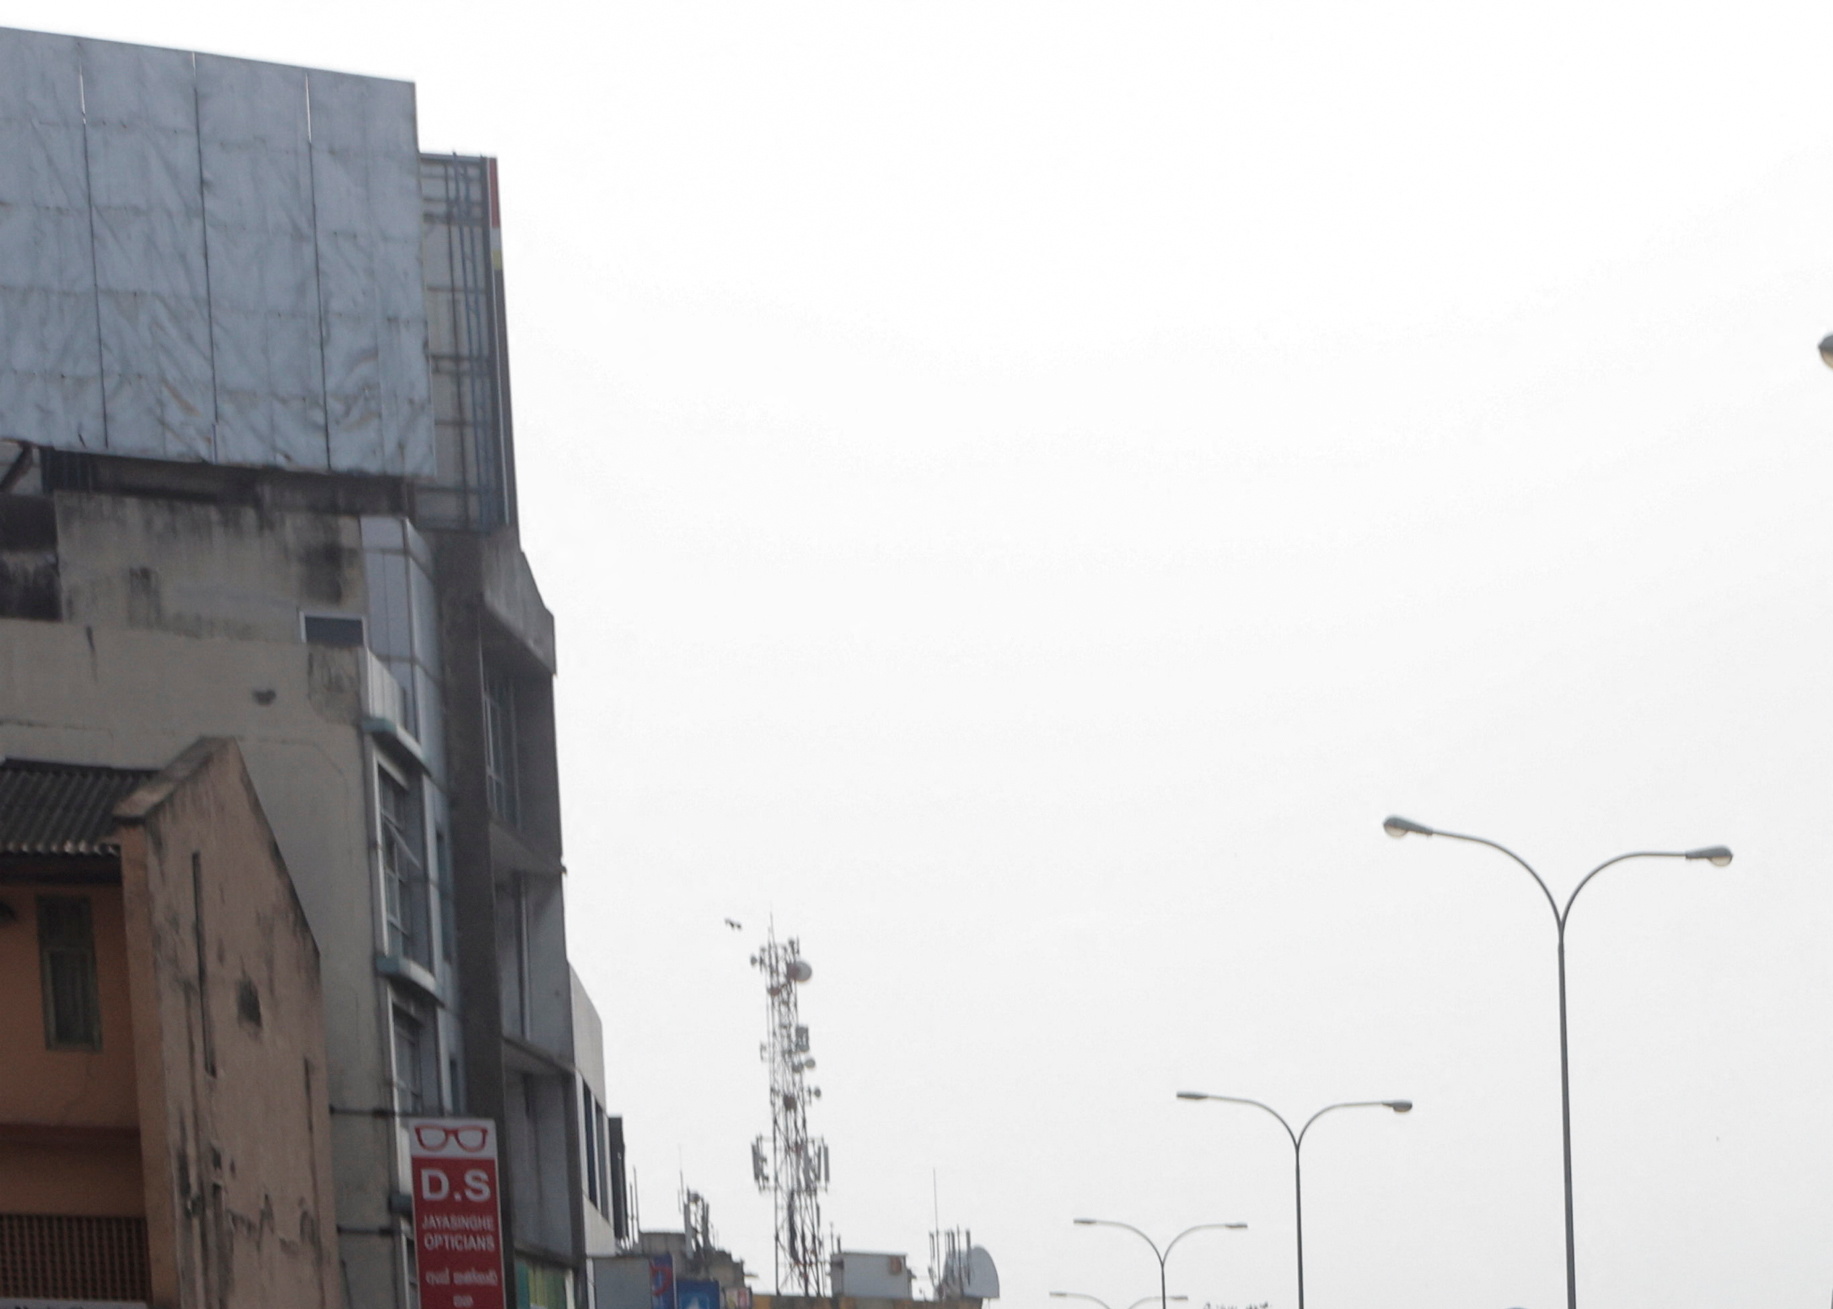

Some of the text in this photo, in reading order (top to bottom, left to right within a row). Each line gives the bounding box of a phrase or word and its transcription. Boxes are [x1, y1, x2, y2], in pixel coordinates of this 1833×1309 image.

[421, 1168, 491, 1203] D.S
[422, 1214, 494, 1232] JAYASINGHE
[424, 1232, 495, 1252] OPTICIANS
